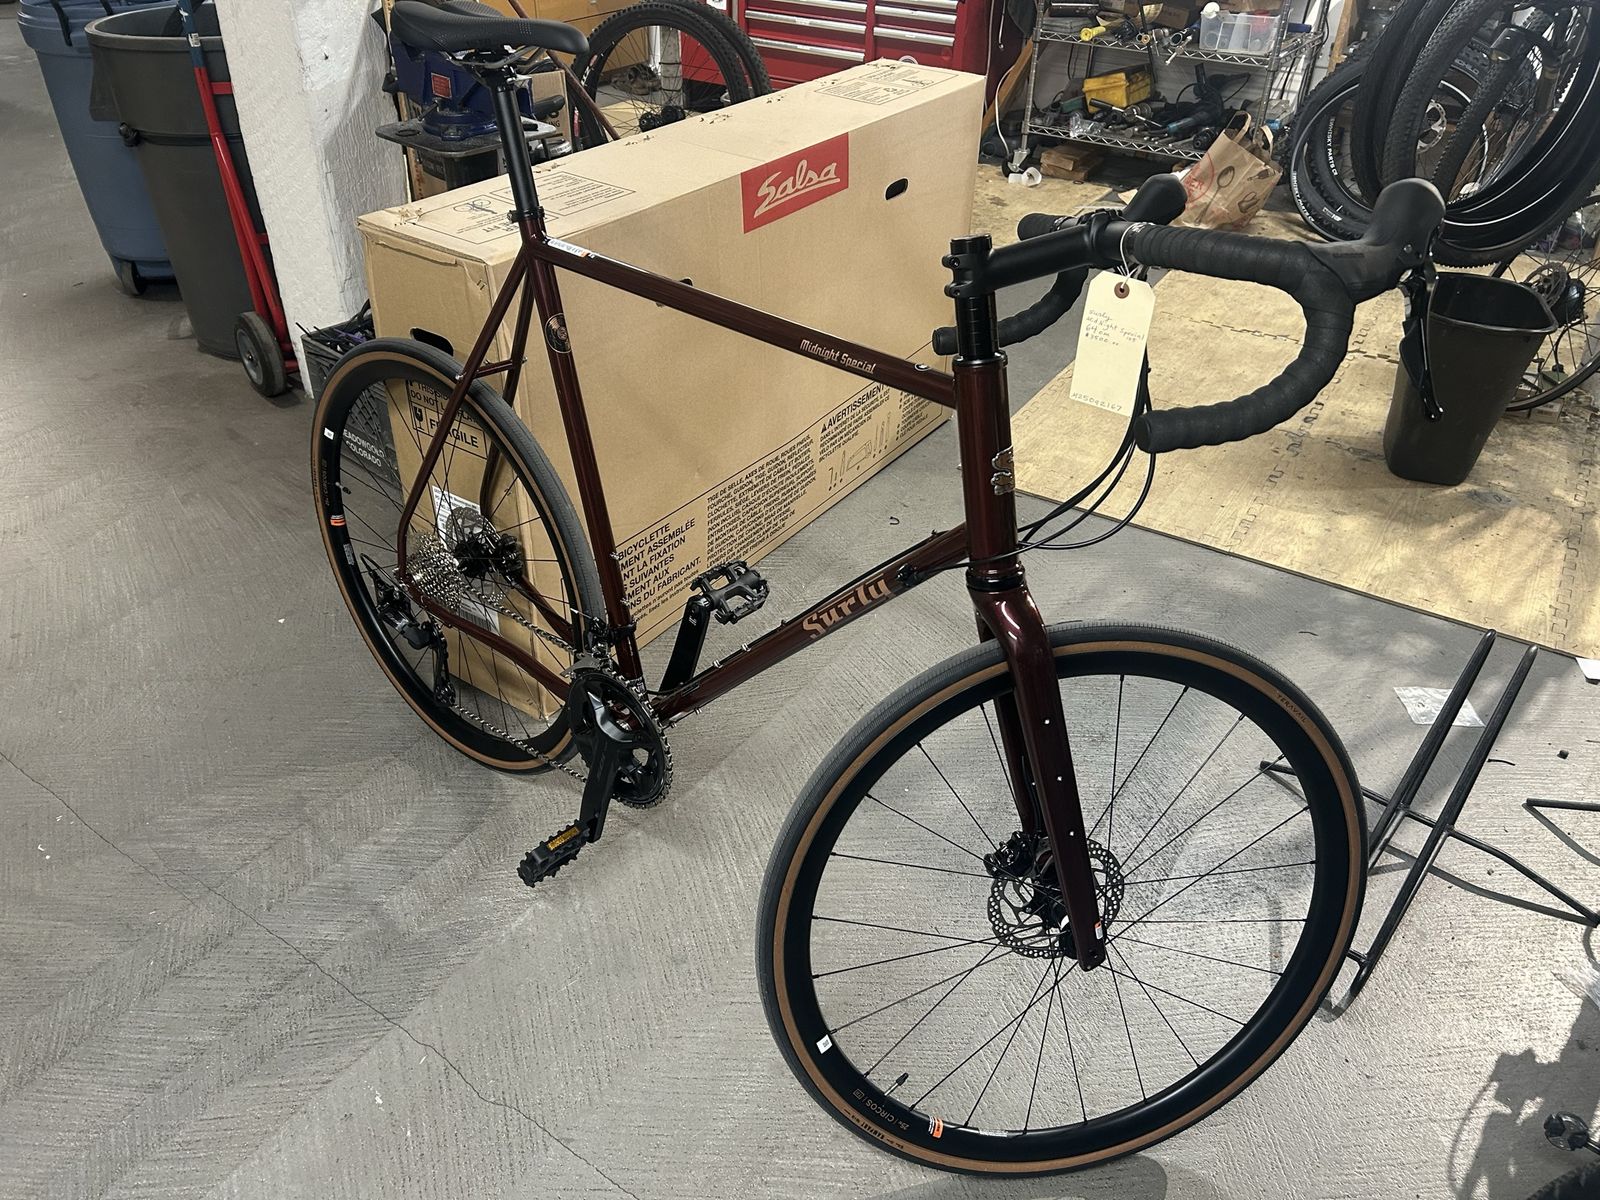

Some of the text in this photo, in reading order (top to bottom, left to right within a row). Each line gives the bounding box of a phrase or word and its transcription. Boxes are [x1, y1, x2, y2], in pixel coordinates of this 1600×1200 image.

[753, 160, 840, 218] Salsa
[800, 340, 876, 374] Midnight Special
[343, 428, 384, 458] EADOWGOLD
[430, 419, 479, 449] FGILE
[346, 441, 382, 467] COLORADO
[618, 522, 670, 561] BICYCLETTE
[620, 516, 695, 572] MENT ASSEMBLÉE
[637, 558, 647, 572] LA
[650, 534, 685, 564] FIXATION
[628, 566, 669, 600] MENT AUX
[629, 552, 674, 588] SUIVANTES
[644, 585, 655, 600] DU
[657, 555, 700, 591] FABRICANT.
[803, 579, 895, 638] Surly
[865, 1098, 895, 1122] CIRCOS
